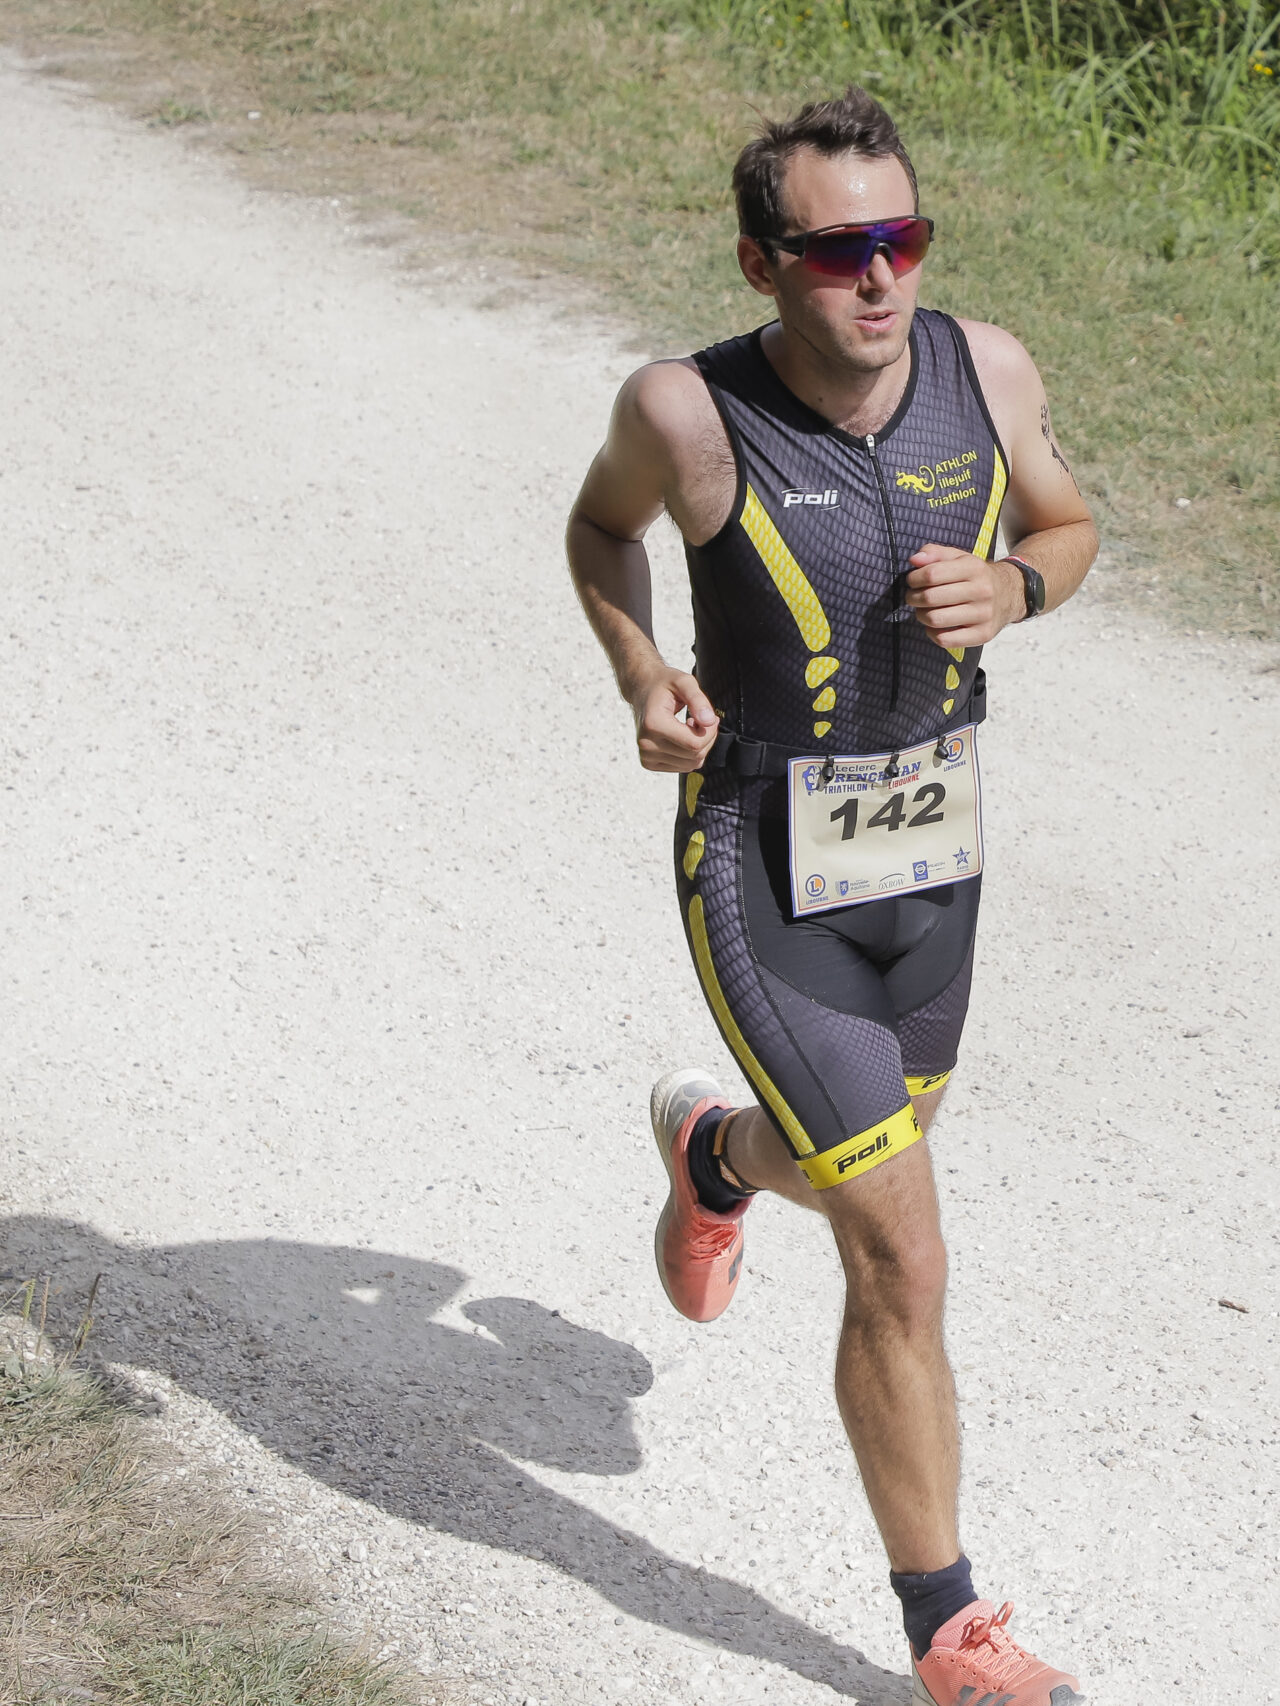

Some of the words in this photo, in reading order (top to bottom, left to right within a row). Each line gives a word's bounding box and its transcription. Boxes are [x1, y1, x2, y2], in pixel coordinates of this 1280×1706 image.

[935, 450, 978, 475] ATHLON
[938, 469, 972, 489] illejuif
[783, 490, 838, 508] poli
[927, 486, 976, 509] Triathlon
[943, 760, 967, 772] LIBOURNE
[824, 783, 868, 794] TRIATHLON
[888, 773, 920, 789] LIBOURNE
[830, 782, 946, 841] 142
[837, 1132, 888, 1175] poli
